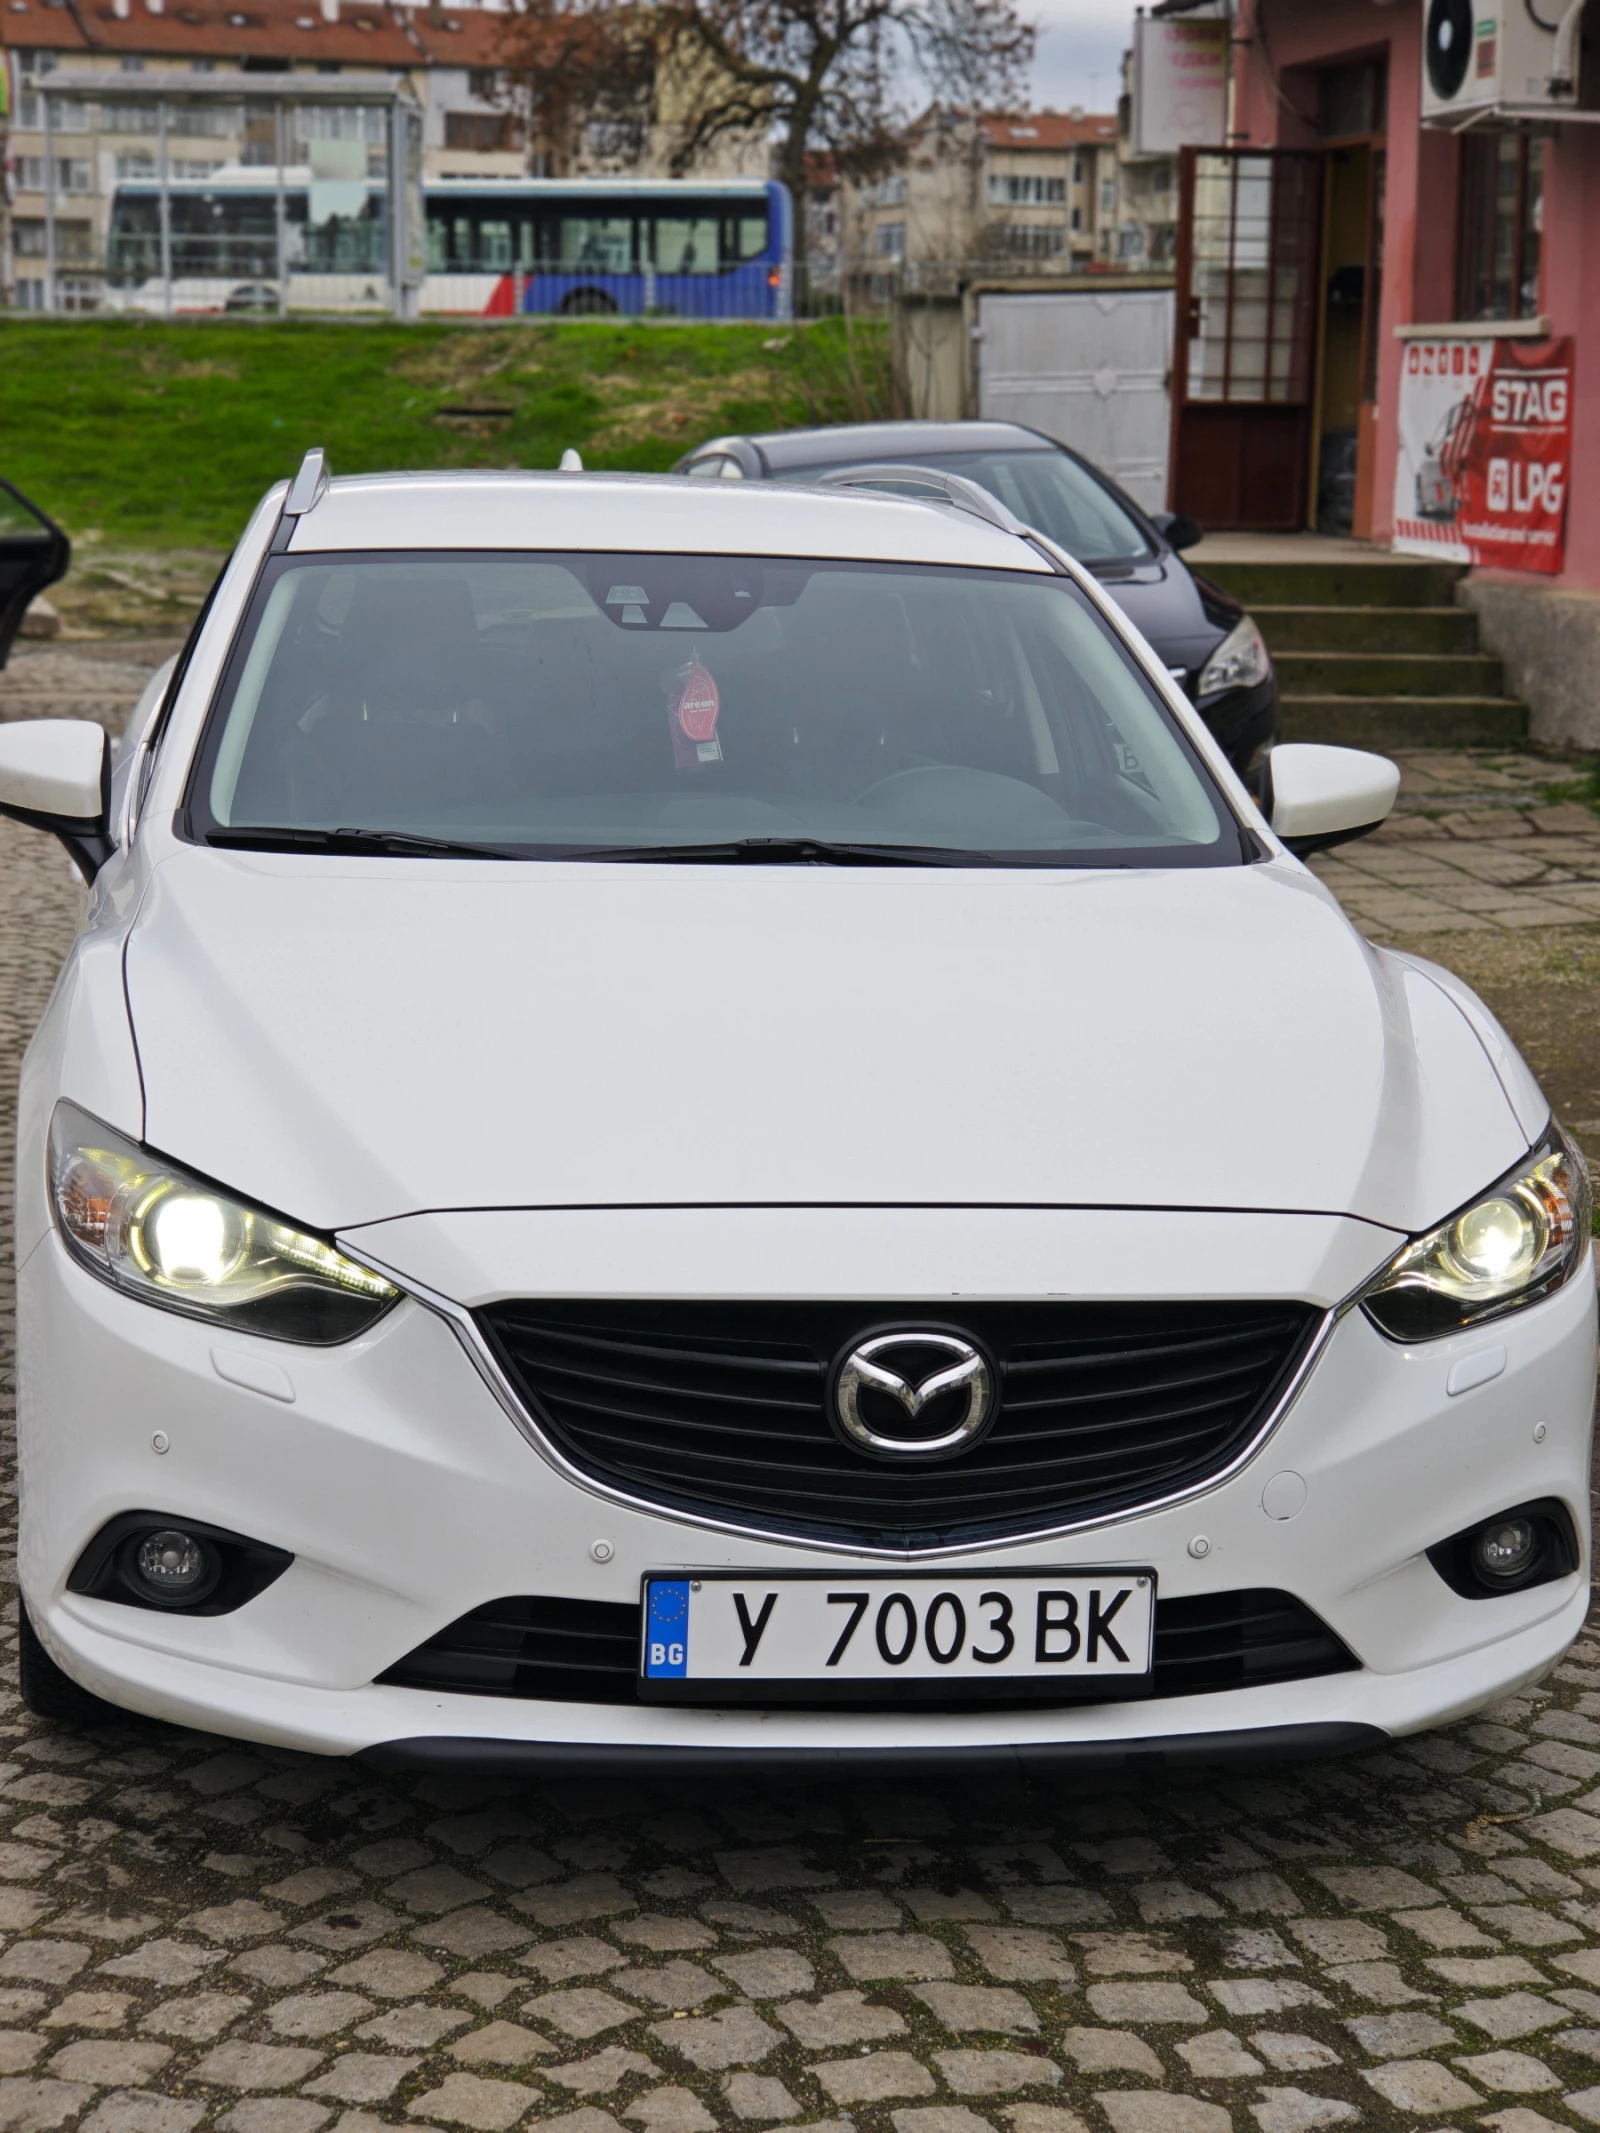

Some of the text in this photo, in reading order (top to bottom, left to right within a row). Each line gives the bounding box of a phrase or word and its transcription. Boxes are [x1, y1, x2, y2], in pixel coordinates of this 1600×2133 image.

[1492, 380, 1568, 422] STAG
[1512, 462, 1564, 514] LPG
[684, 700, 715, 710] areon
[825, 1591, 1015, 1666] 7003
[1035, 1589, 1133, 1663] BK
[650, 1643, 683, 1666] BG
